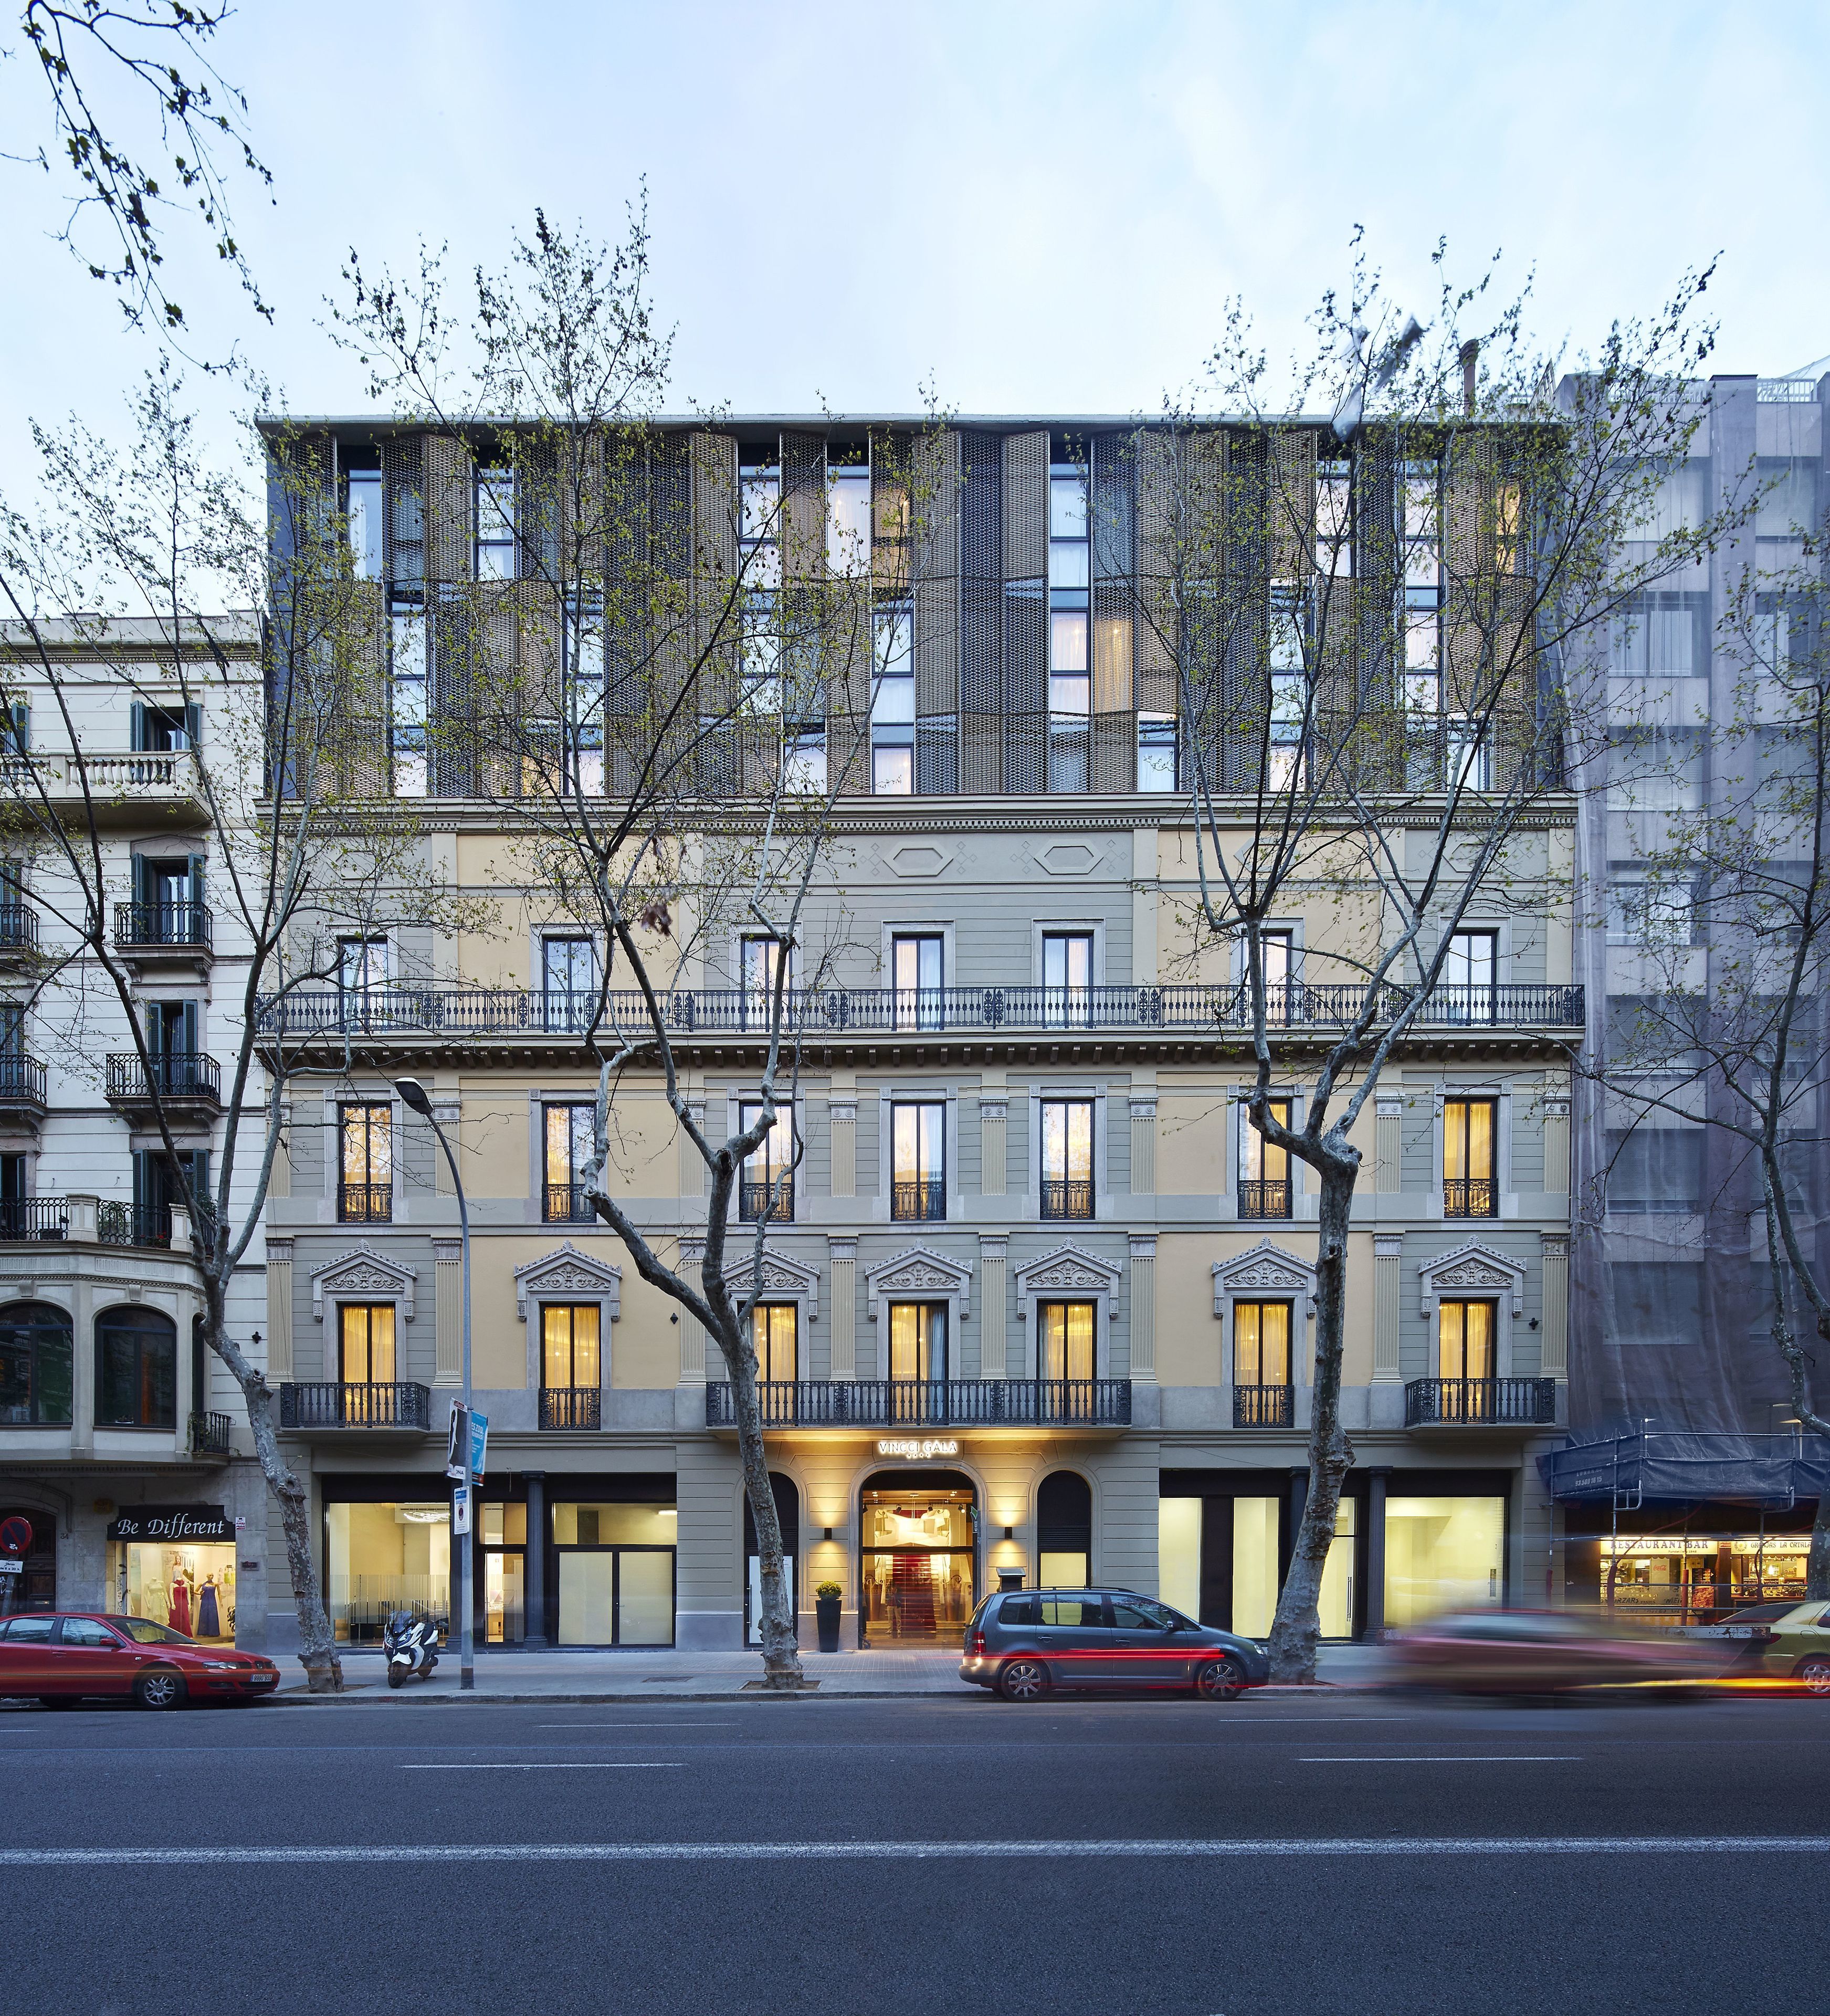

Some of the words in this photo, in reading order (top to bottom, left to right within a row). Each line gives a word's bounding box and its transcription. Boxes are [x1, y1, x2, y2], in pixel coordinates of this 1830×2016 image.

[880, 1443, 918, 1452] VINCCI
[924, 1442, 956, 1452] GALA
[118, 1519, 139, 1535] Be
[148, 1513, 224, 1538] Different
